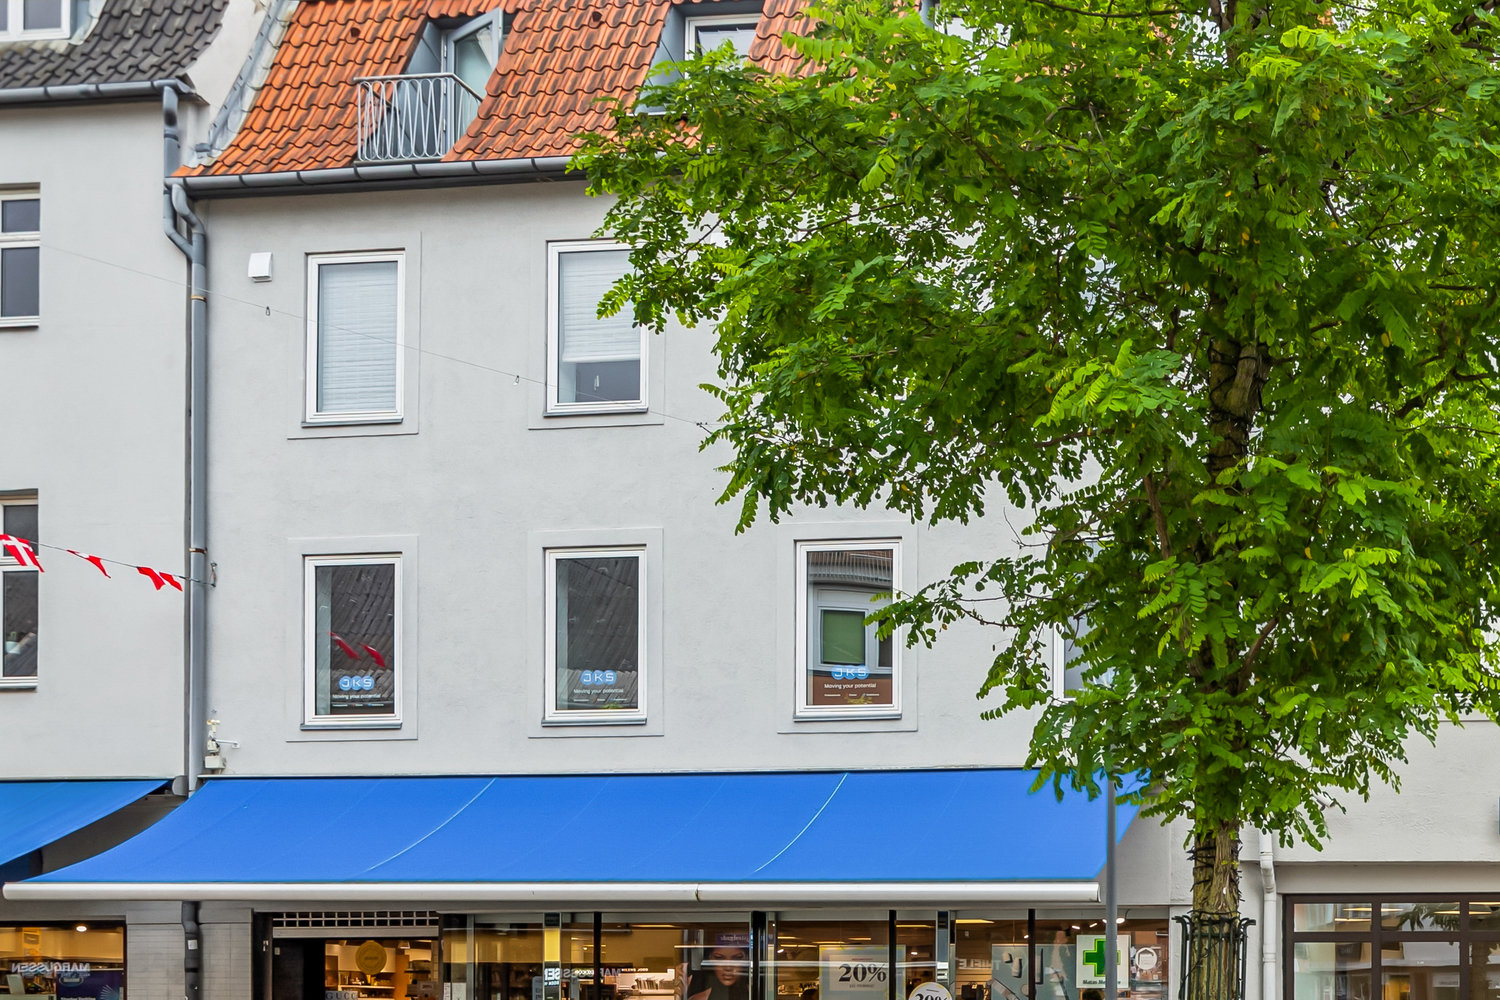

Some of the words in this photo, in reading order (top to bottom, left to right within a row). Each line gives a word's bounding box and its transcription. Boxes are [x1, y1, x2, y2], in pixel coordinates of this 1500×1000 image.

[583, 672, 614, 682] JKS
[834, 667, 866, 677] JKS
[341, 678, 372, 688] JKS
[838, 963, 887, 982] 20%
